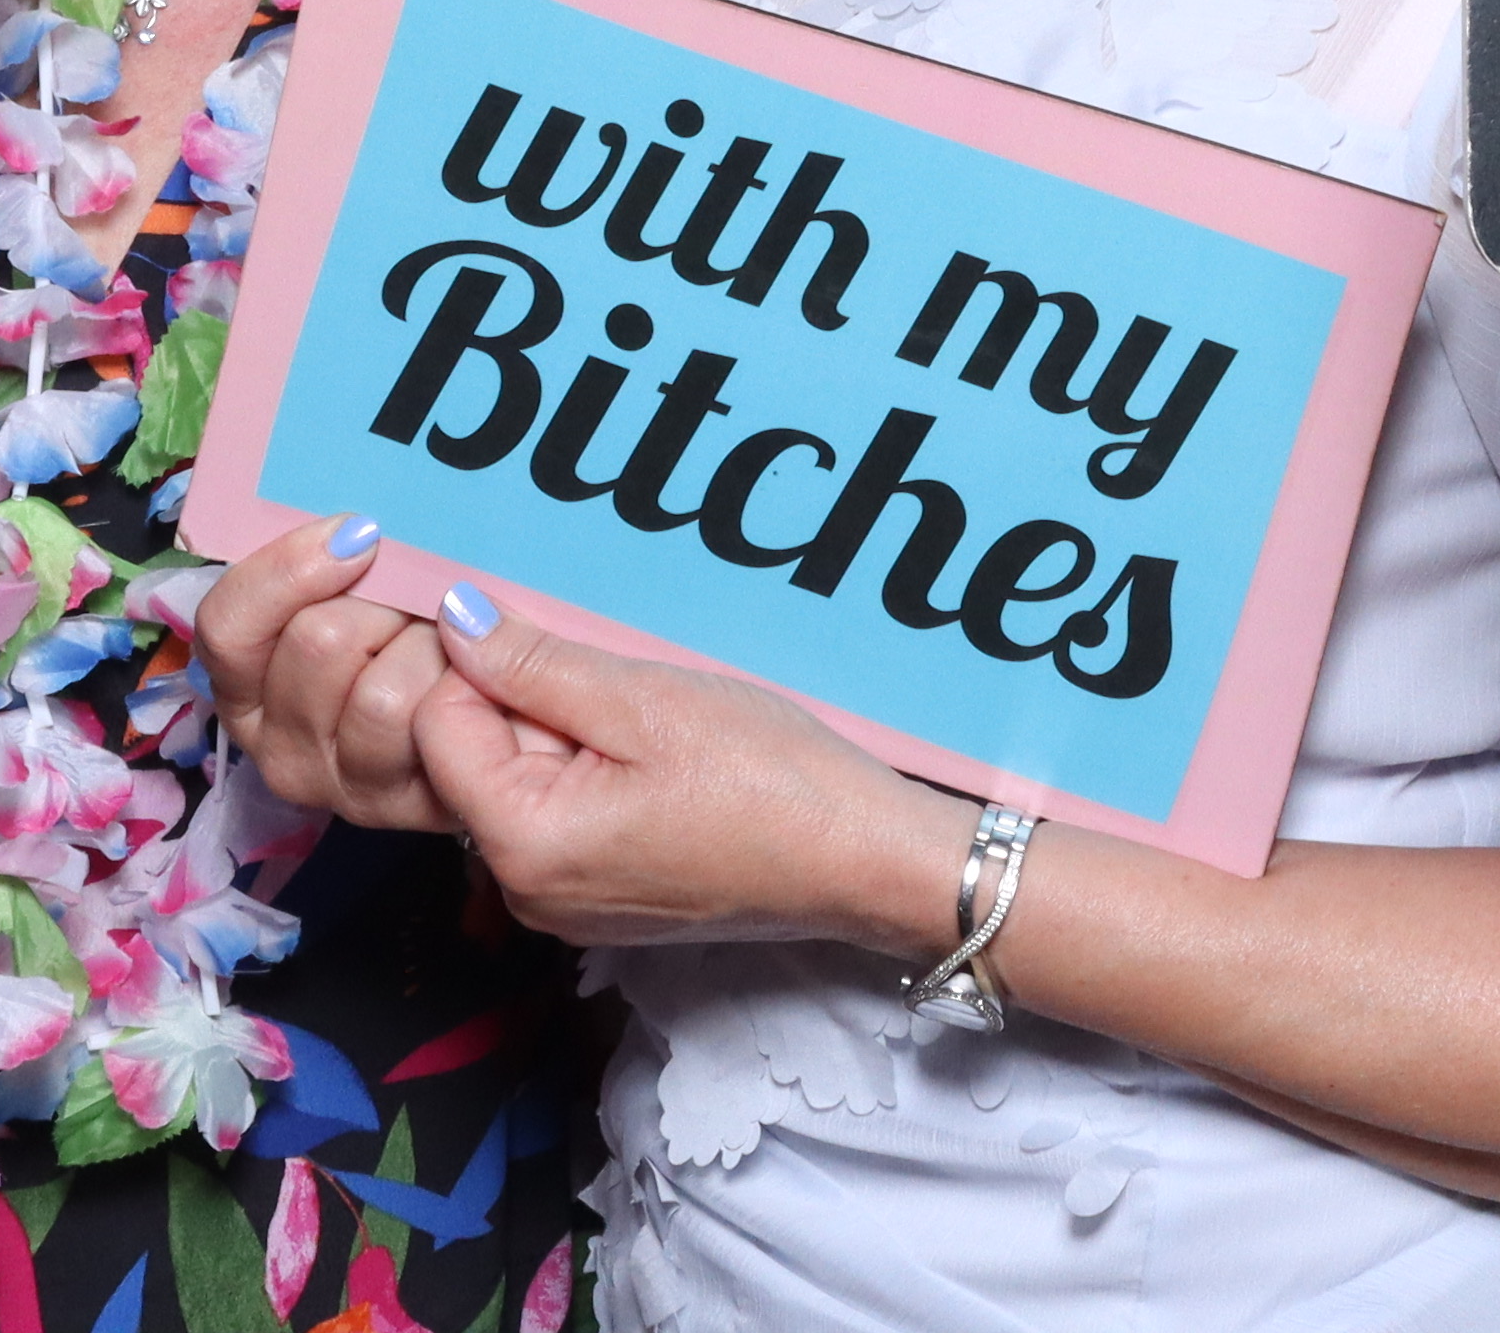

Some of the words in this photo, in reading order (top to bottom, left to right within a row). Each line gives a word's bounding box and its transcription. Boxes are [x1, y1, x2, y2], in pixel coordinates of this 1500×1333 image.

[367, 239, 1180, 701] Bitches
[440, 83, 872, 332] with
[893, 249, 1239, 501] my
